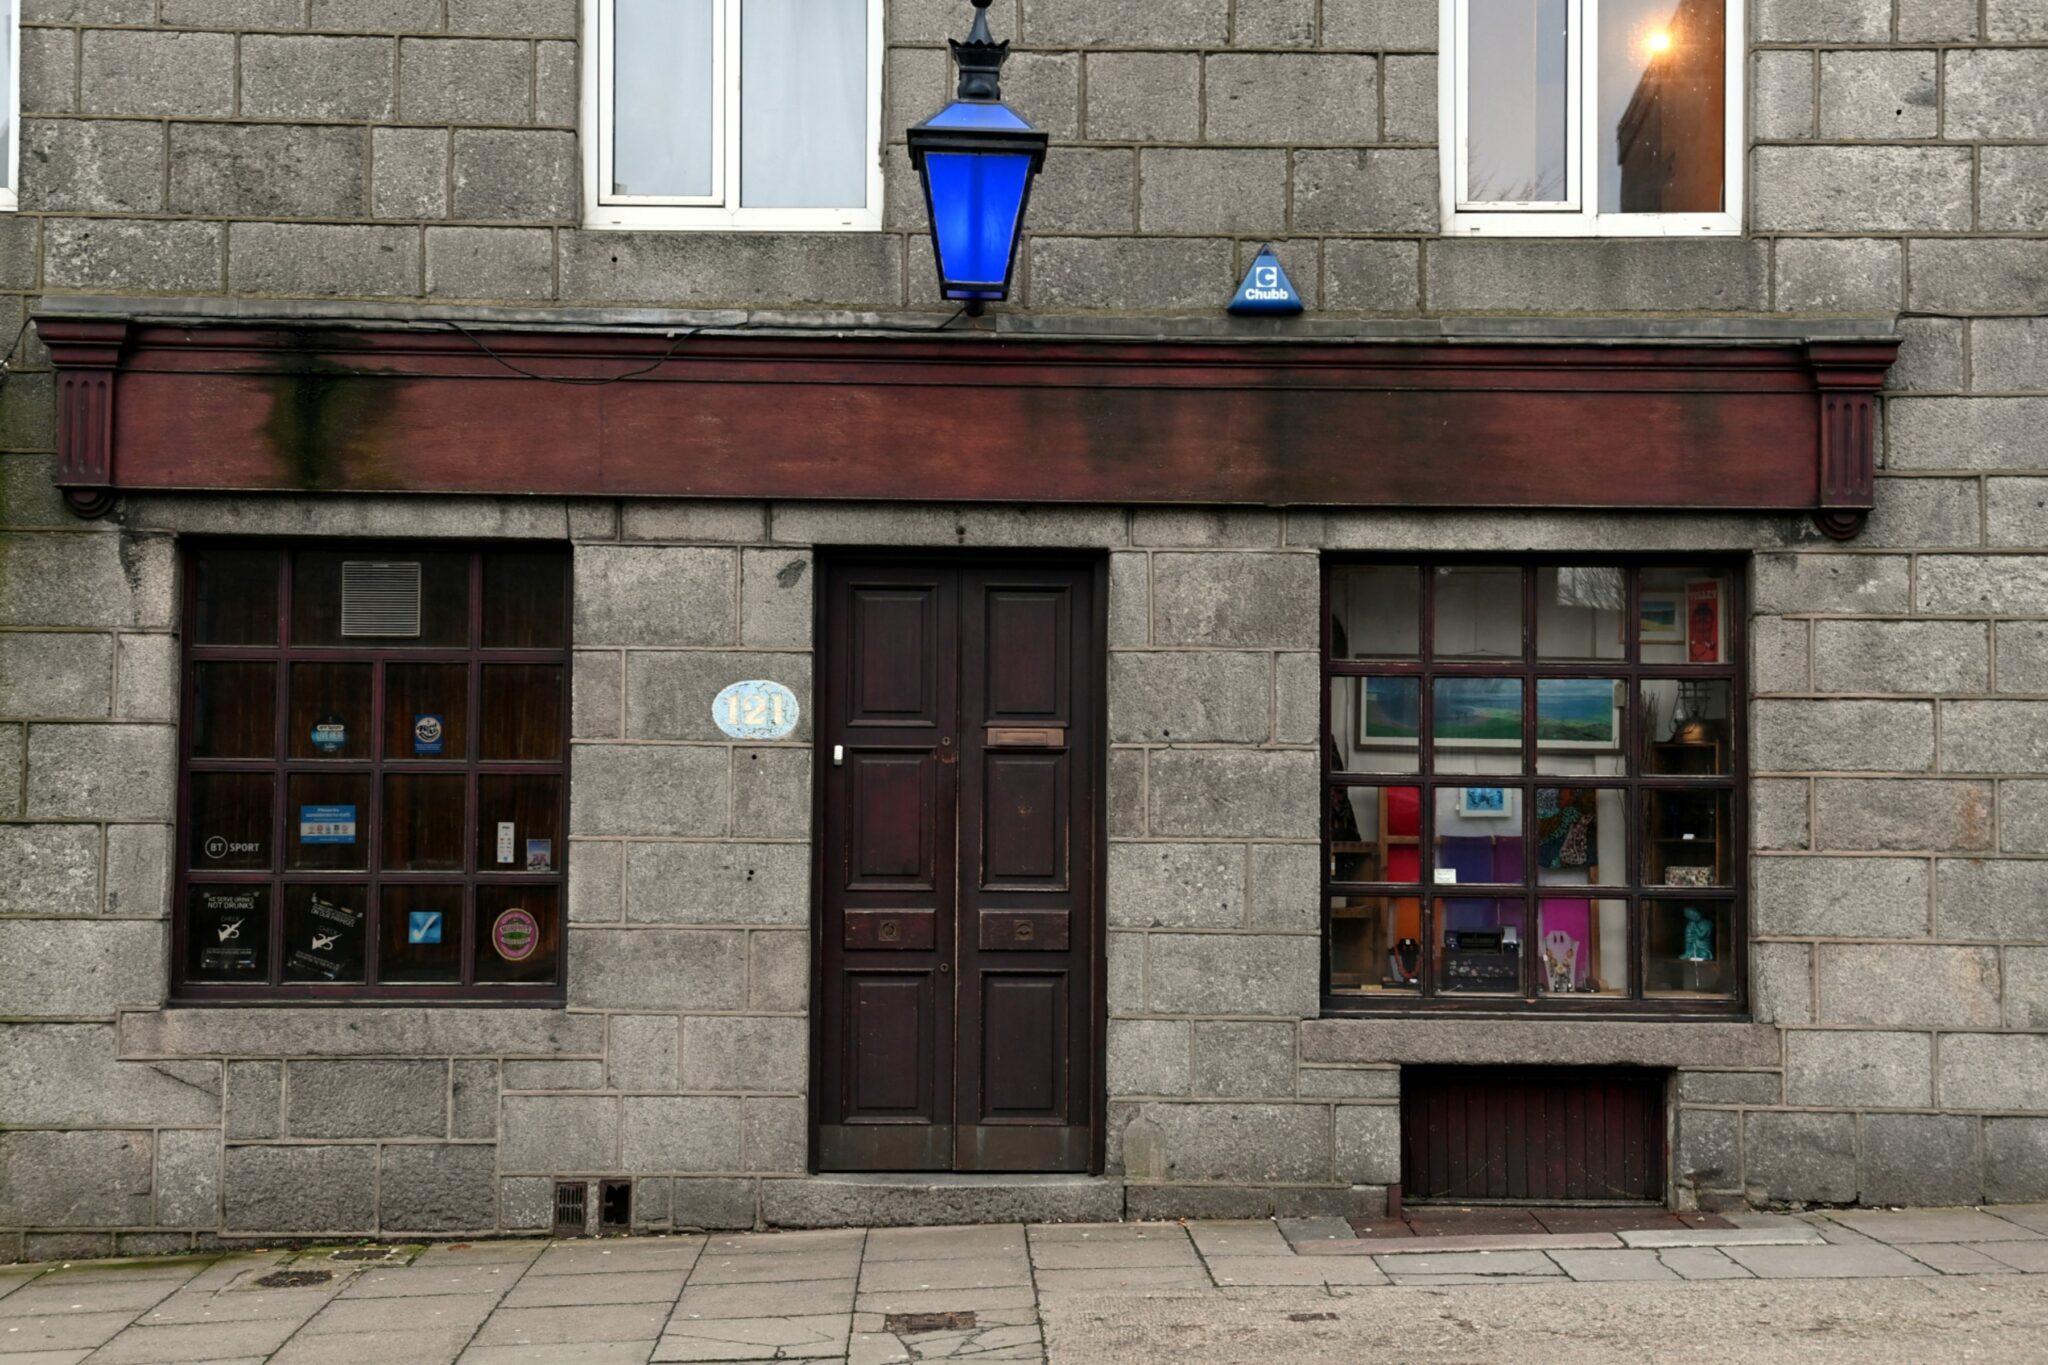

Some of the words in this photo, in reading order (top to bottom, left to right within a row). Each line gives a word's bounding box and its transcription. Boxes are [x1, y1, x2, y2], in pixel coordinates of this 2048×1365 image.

[1245, 288, 1289, 300] Chubb
[726, 694, 783, 725] 121
[210, 843, 223, 851] BT
[229, 843, 260, 852] SPORT
[223, 902, 254, 910] DRUNKS
